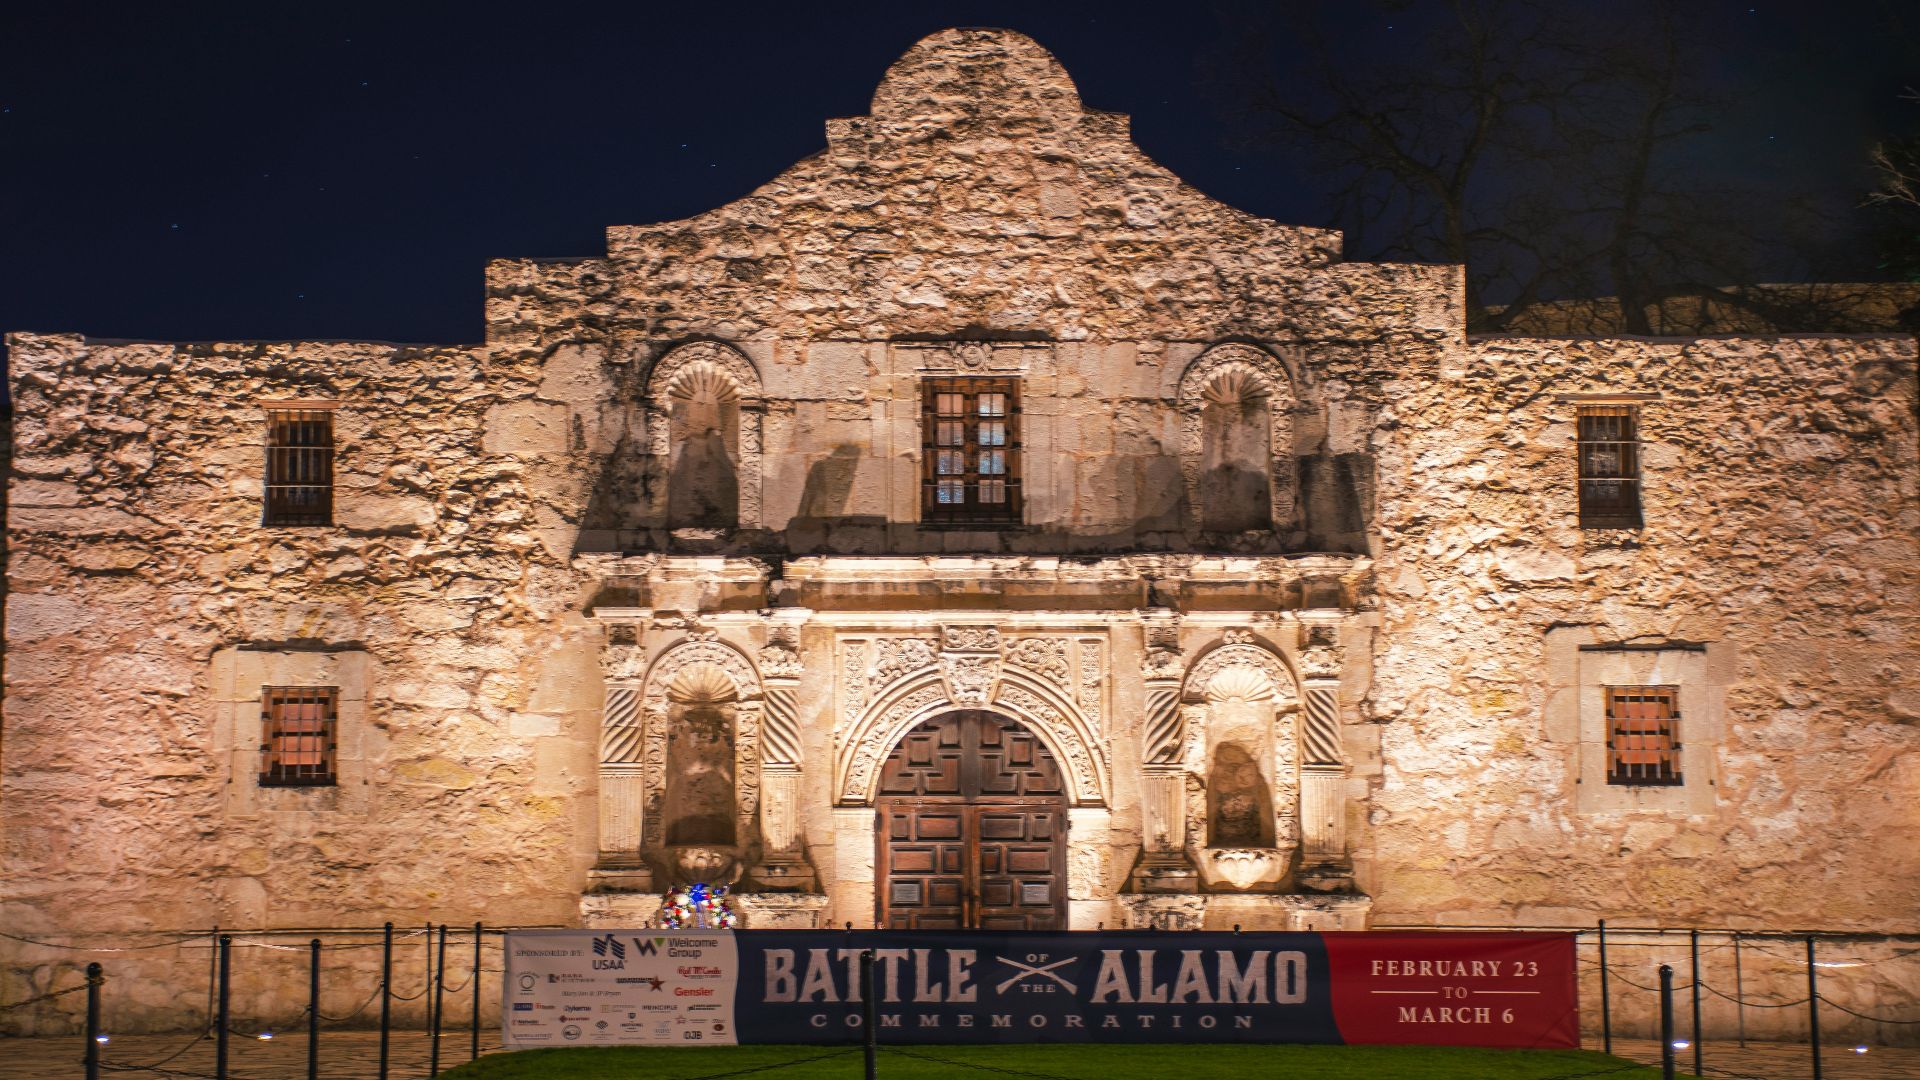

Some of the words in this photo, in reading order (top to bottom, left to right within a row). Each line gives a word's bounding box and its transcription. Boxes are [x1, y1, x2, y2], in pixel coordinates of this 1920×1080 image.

[668, 938, 718, 948] Welcome
[668, 948, 702, 959] Group
[1025, 953, 1049, 963] OF
[592, 960, 625, 970] USAA
[1370, 960, 1502, 977] FEBRUARY
[1512, 961, 1539, 977] 23
[763, 948, 978, 1003] BATTLE
[1089, 949, 1308, 1005] ALAMO
[674, 987, 715, 997] Gensler
[1020, 984, 1056, 993] THE
[1442, 986, 1468, 999] TO
[810, 1014, 1253, 1028] COMMEMORATION
[1399, 1006, 1492, 1024] MARCH
[1502, 1008, 1515, 1024] 6
